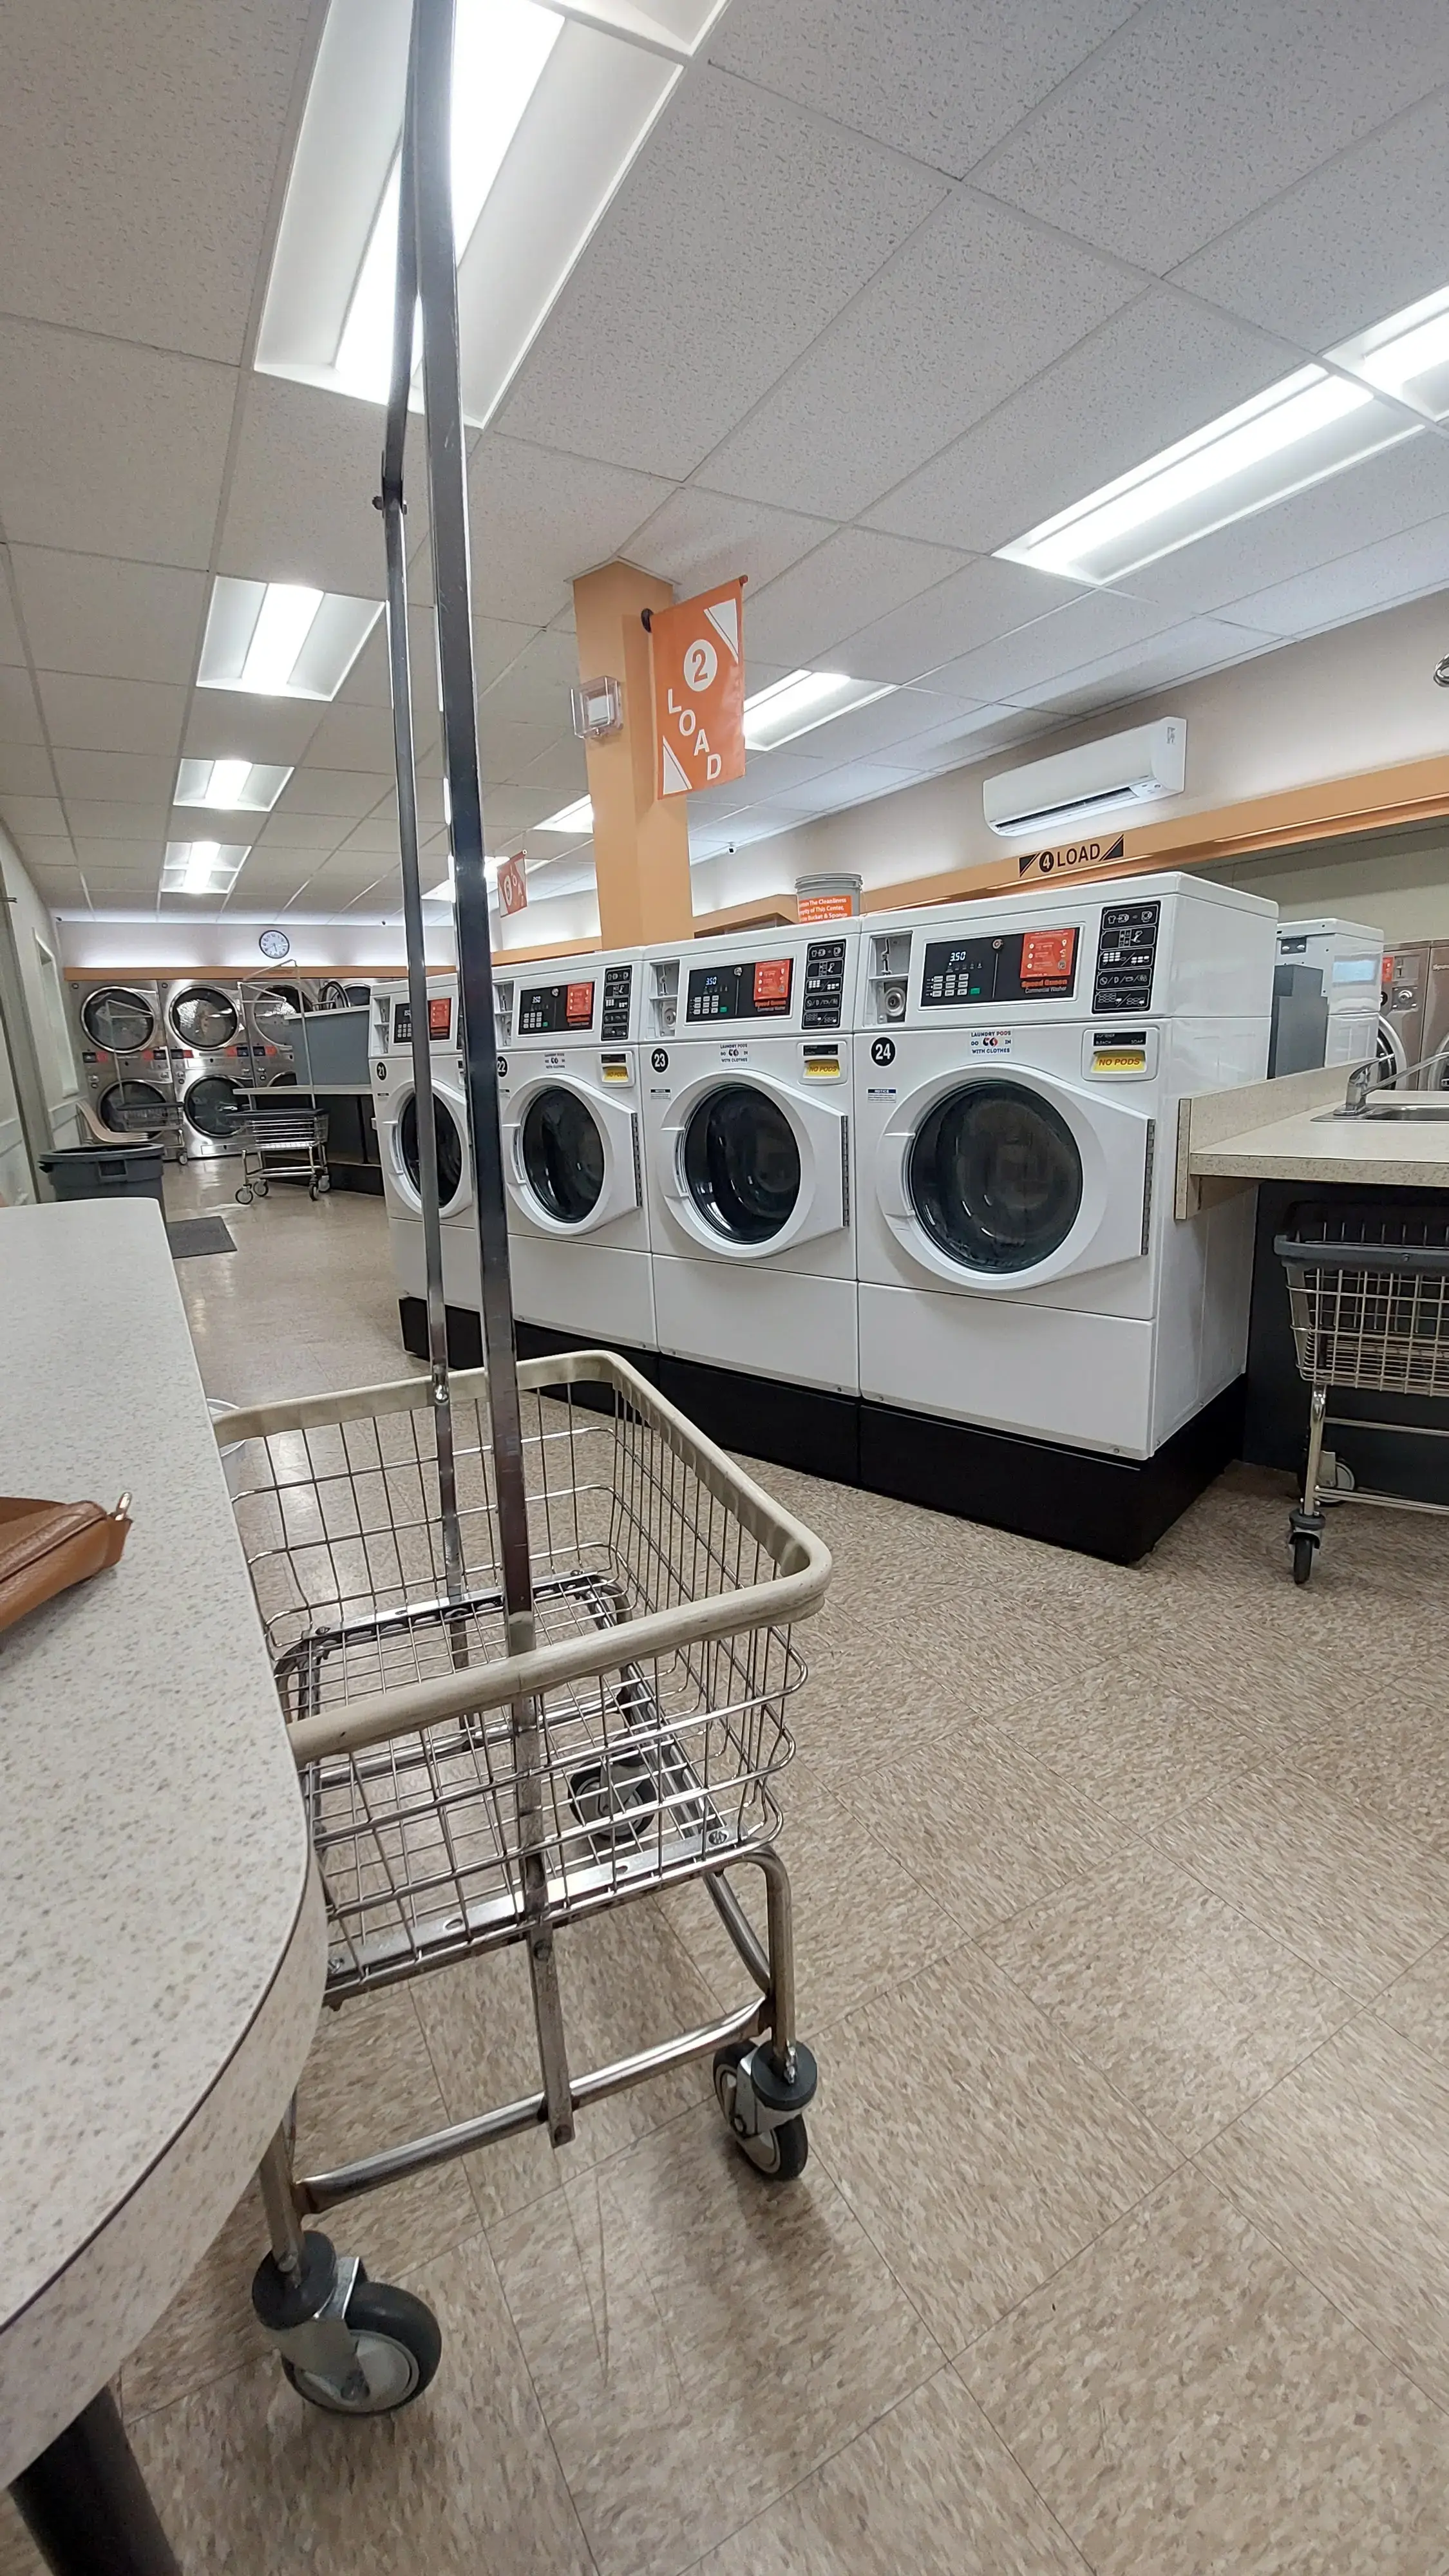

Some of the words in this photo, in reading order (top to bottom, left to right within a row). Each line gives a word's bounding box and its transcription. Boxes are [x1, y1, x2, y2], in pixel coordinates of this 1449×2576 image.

[692, 649, 708, 683] 2
[668, 688, 722, 781] LOAD
[1042, 854, 1051, 869] 4
[1057, 843, 1101, 867] LOAD
[654, 1053, 666, 1067] 23
[875, 1043, 891, 1060] 24
[378, 1066, 385, 1076] 21
[497, 1061, 506, 1072] 22
